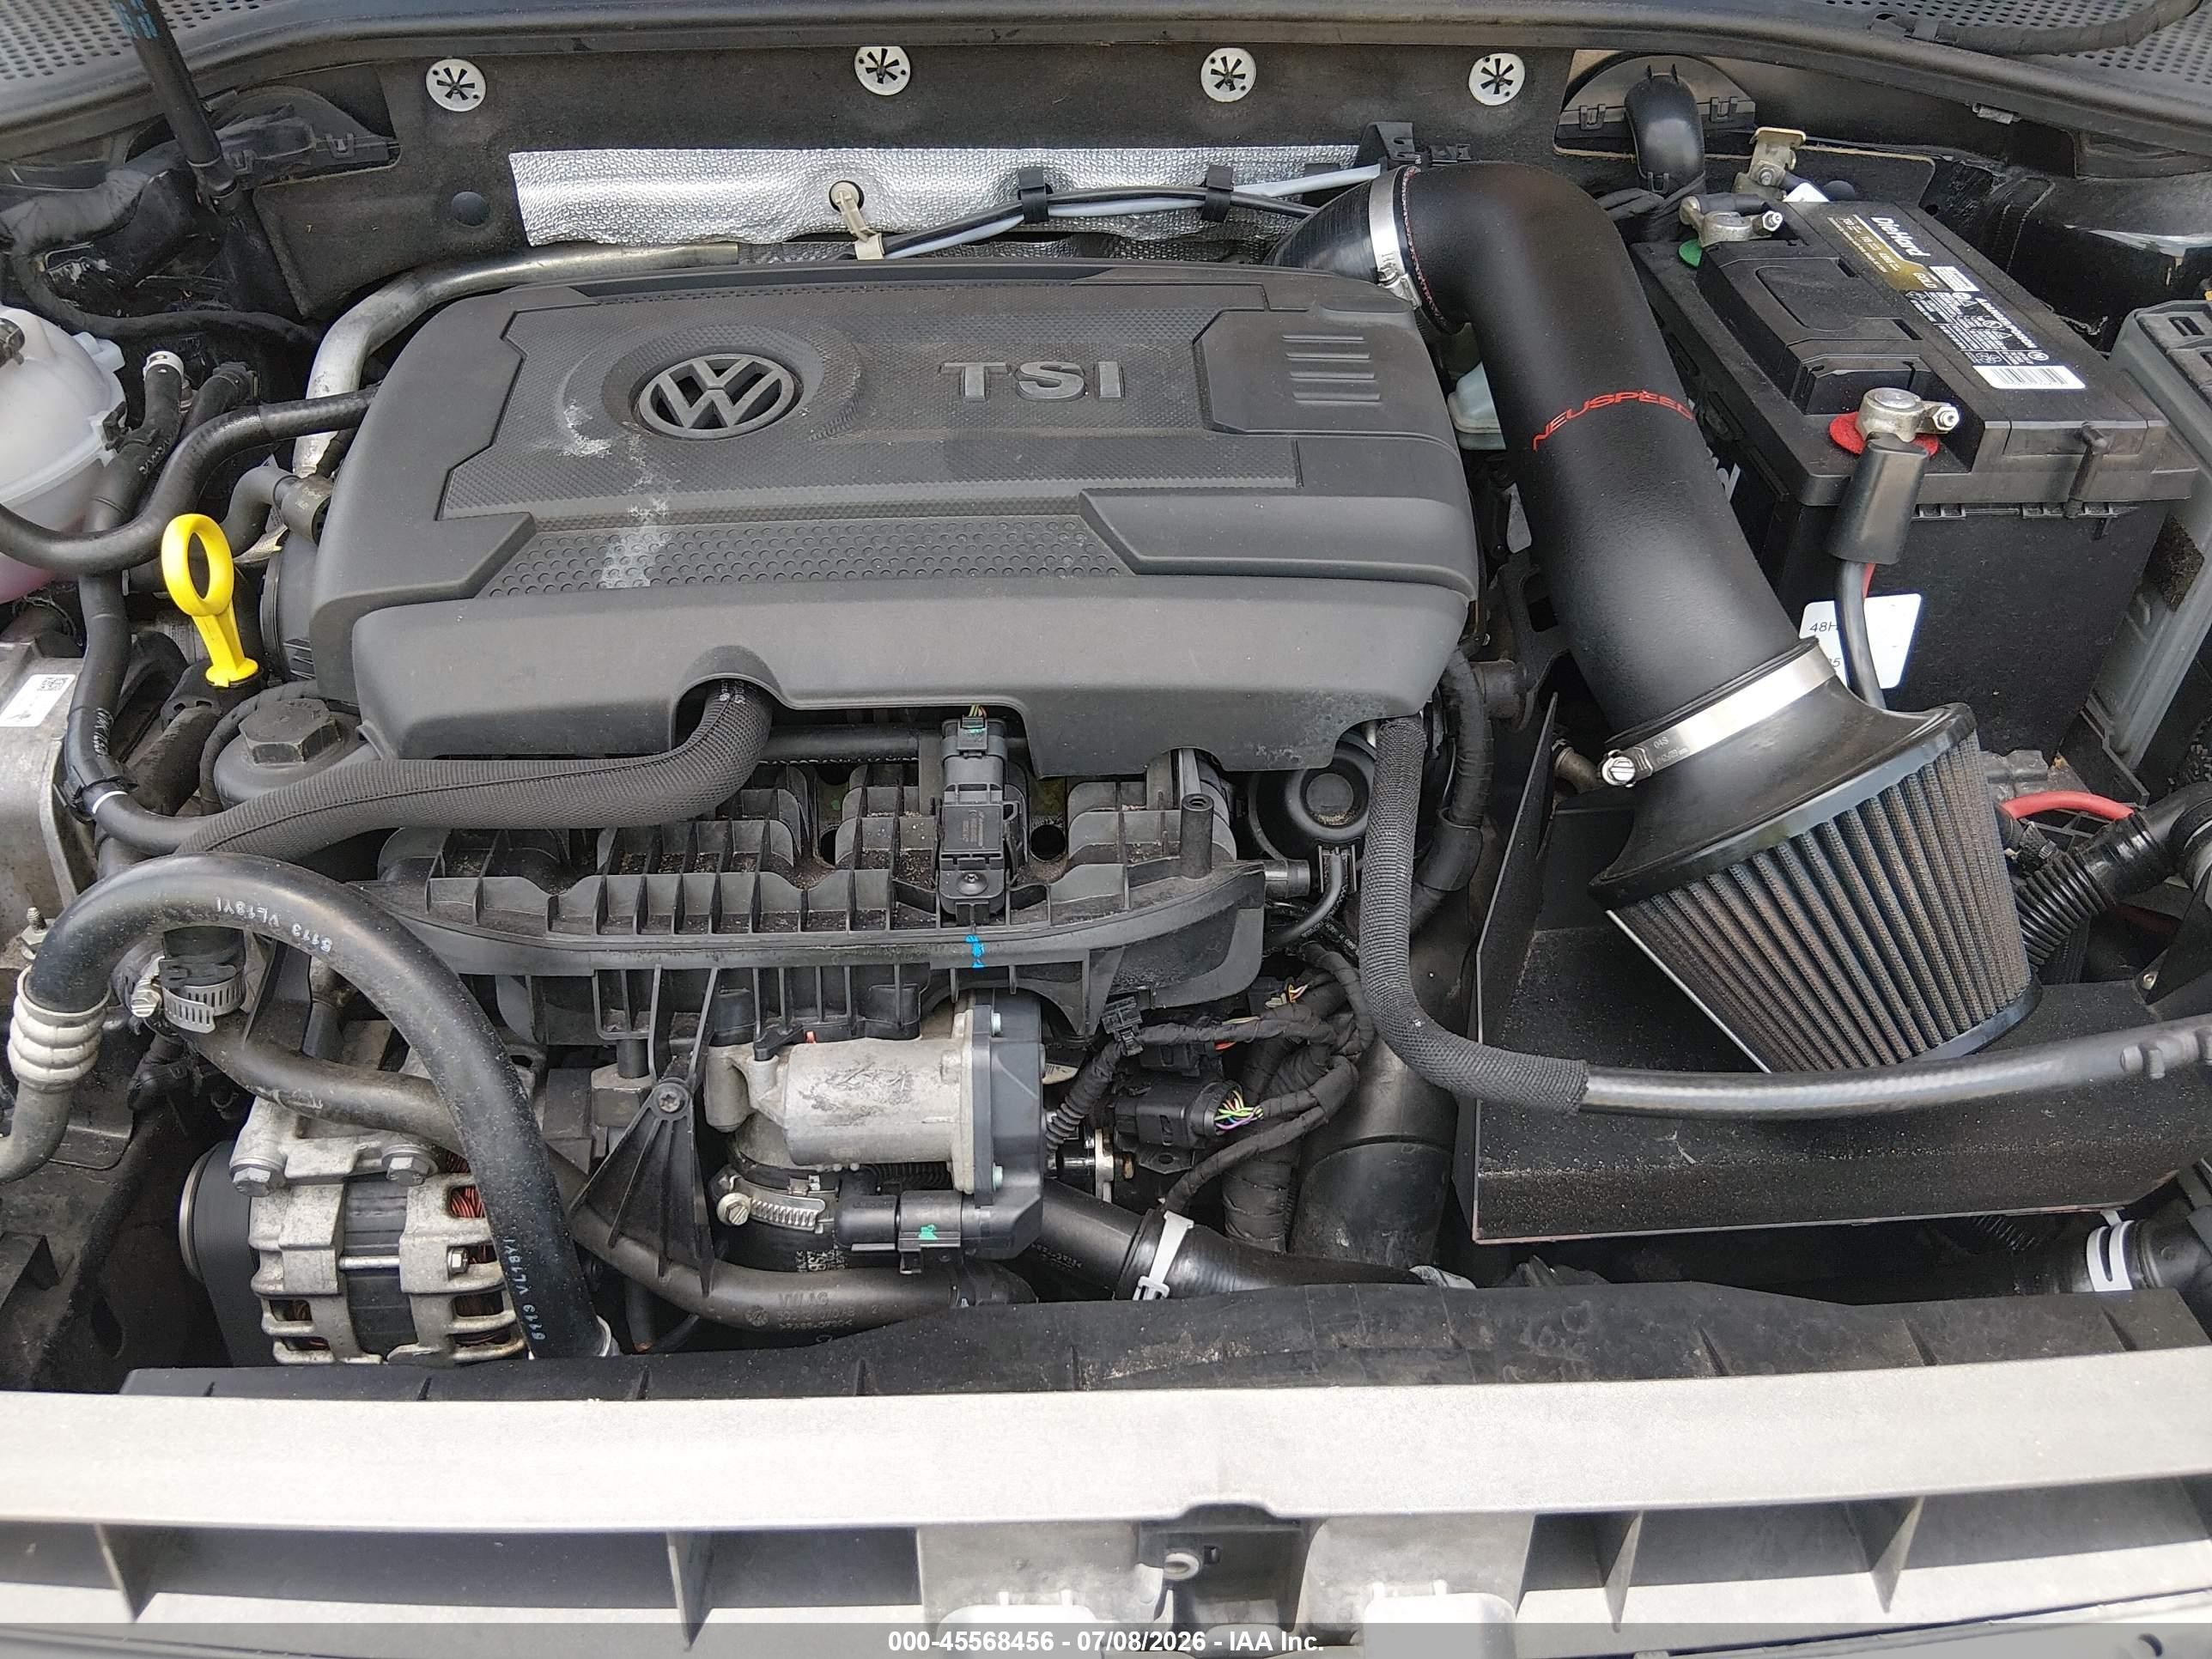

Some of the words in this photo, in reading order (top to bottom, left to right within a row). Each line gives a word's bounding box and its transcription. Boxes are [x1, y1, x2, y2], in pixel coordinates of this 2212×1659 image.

[1870, 216, 1931, 257] DieHard
[1912, 272, 1938, 289] GOLD
[945, 362, 1126, 402] TSI
[1533, 389, 1694, 452] NEUSPEED
